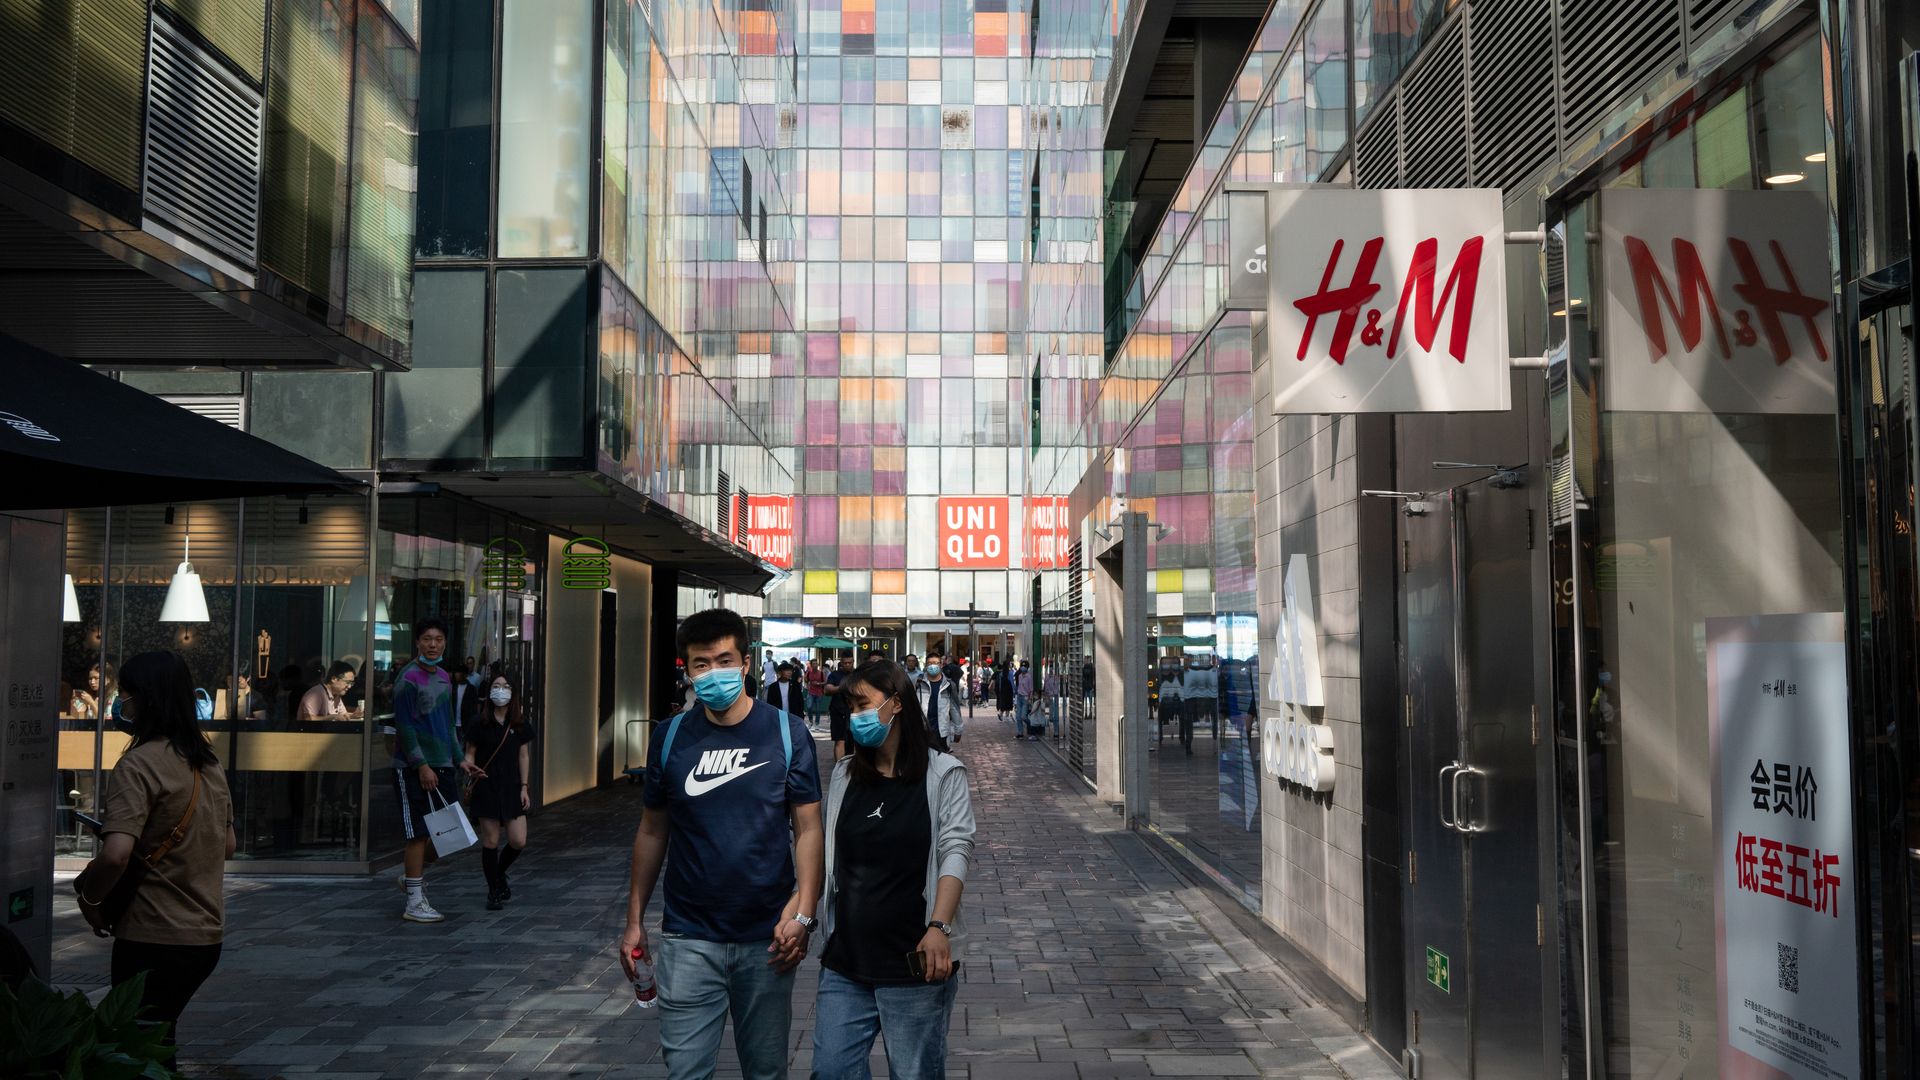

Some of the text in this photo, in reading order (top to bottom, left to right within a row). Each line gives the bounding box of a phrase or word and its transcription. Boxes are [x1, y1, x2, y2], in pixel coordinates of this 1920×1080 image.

[1293, 236, 1485, 364] H&M
[947, 506, 996, 530] UNI
[947, 534, 1001, 563] QLO
[843, 626, 868, 638] S10
[695, 748, 751, 775] NIKE
[1750, 759, 1818, 821] 会员价
[1736, 831, 1841, 919] 低至五折
